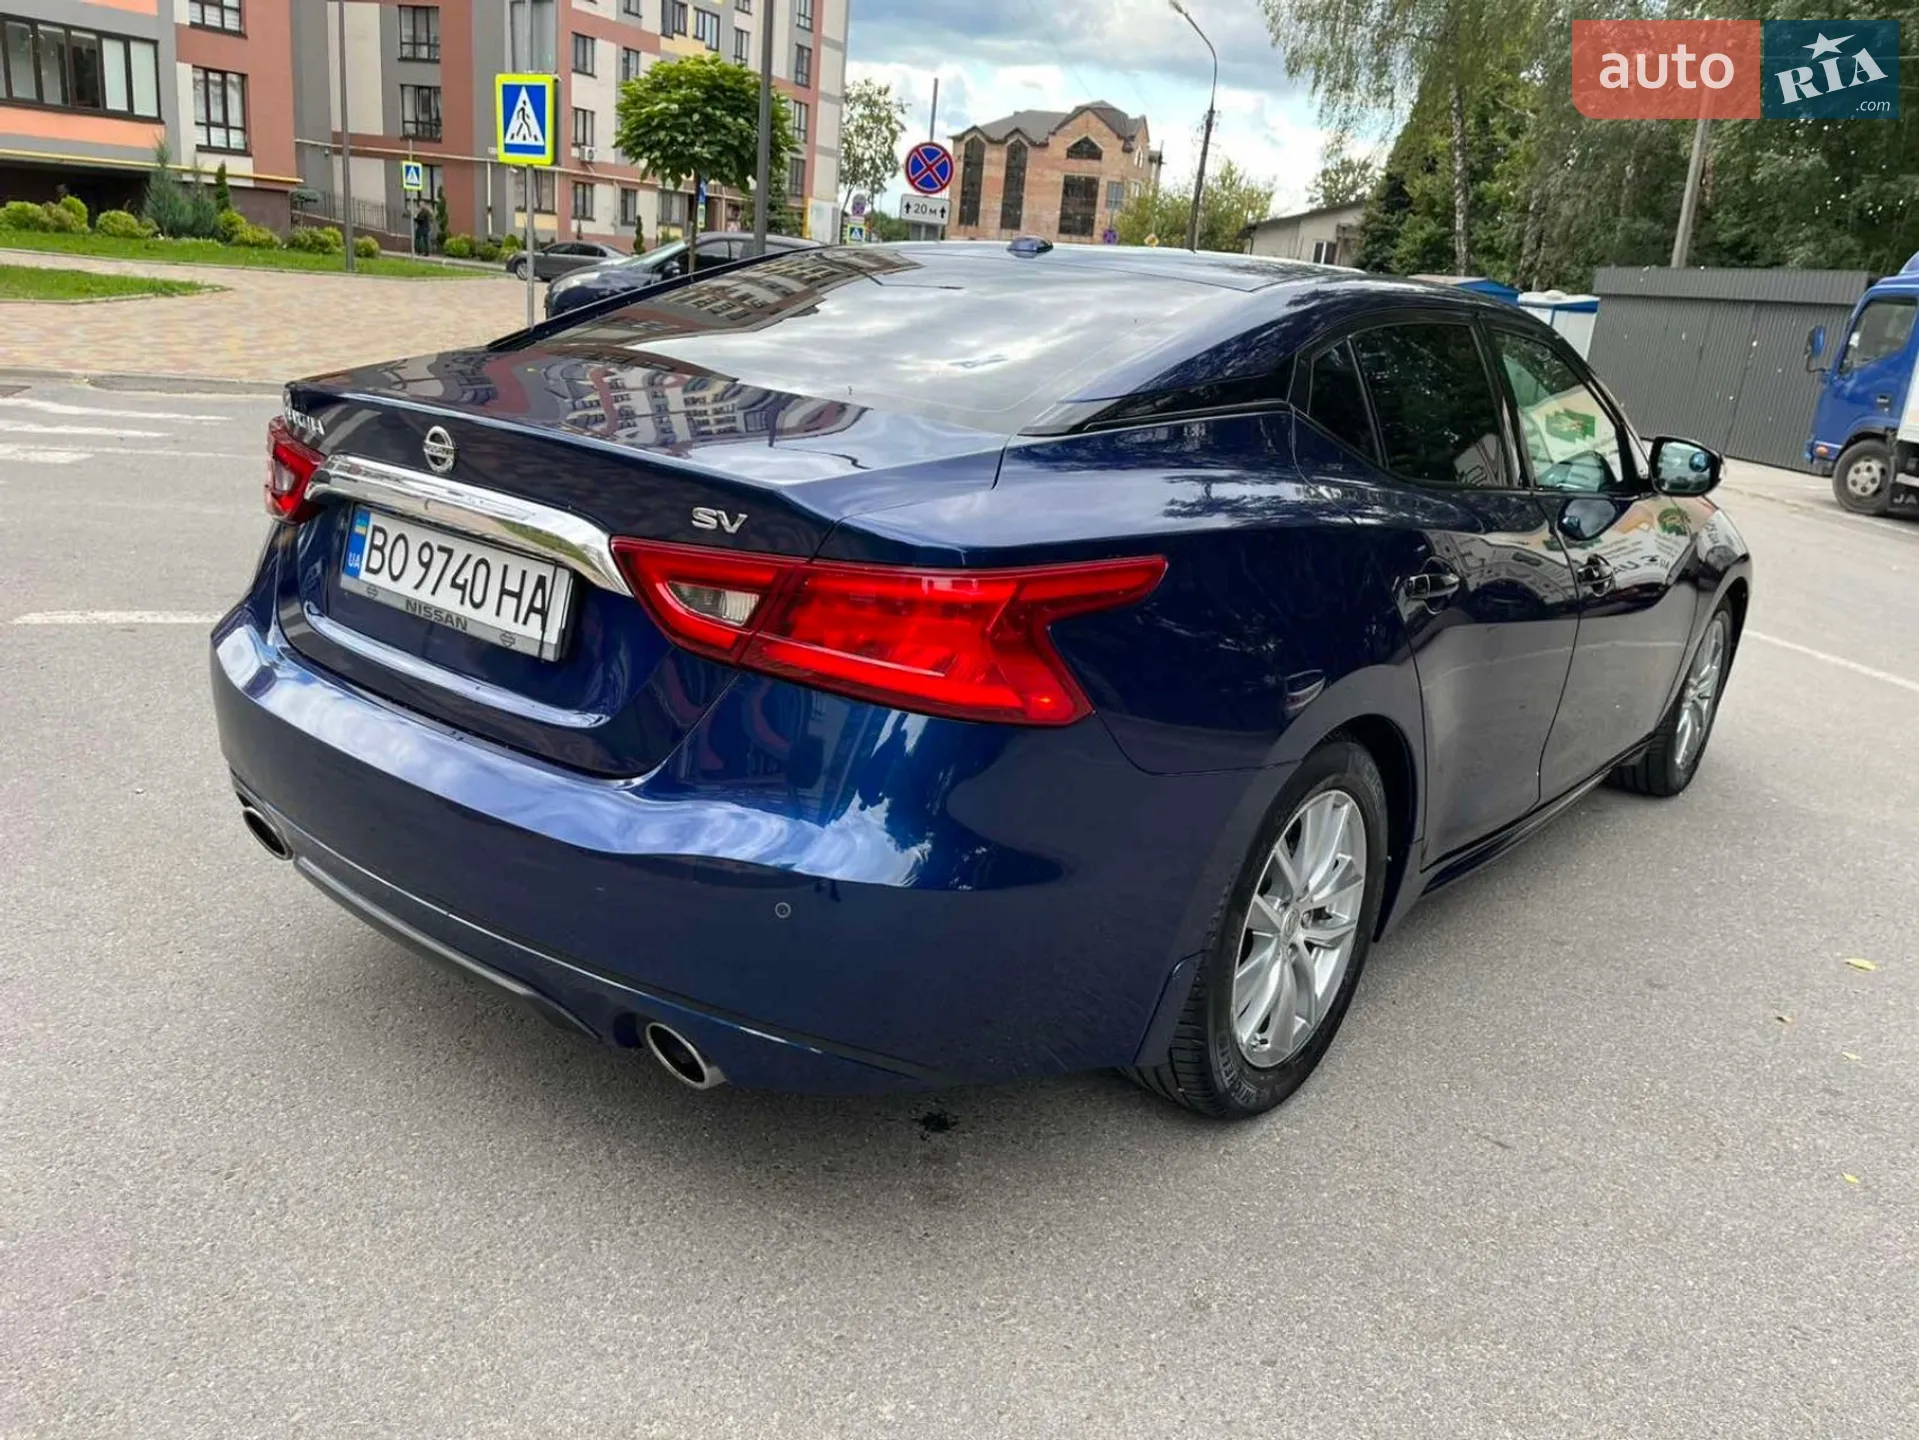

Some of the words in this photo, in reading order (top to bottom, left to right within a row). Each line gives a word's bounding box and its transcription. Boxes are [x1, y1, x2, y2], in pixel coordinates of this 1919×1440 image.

[914, 202, 928, 215] 20
[691, 507, 748, 533] SV
[348, 551, 361, 569] UA
[364, 524, 409, 582] BO
[413, 541, 491, 610] 9740
[495, 564, 548, 631] HA
[405, 599, 468, 632] NISSAN
